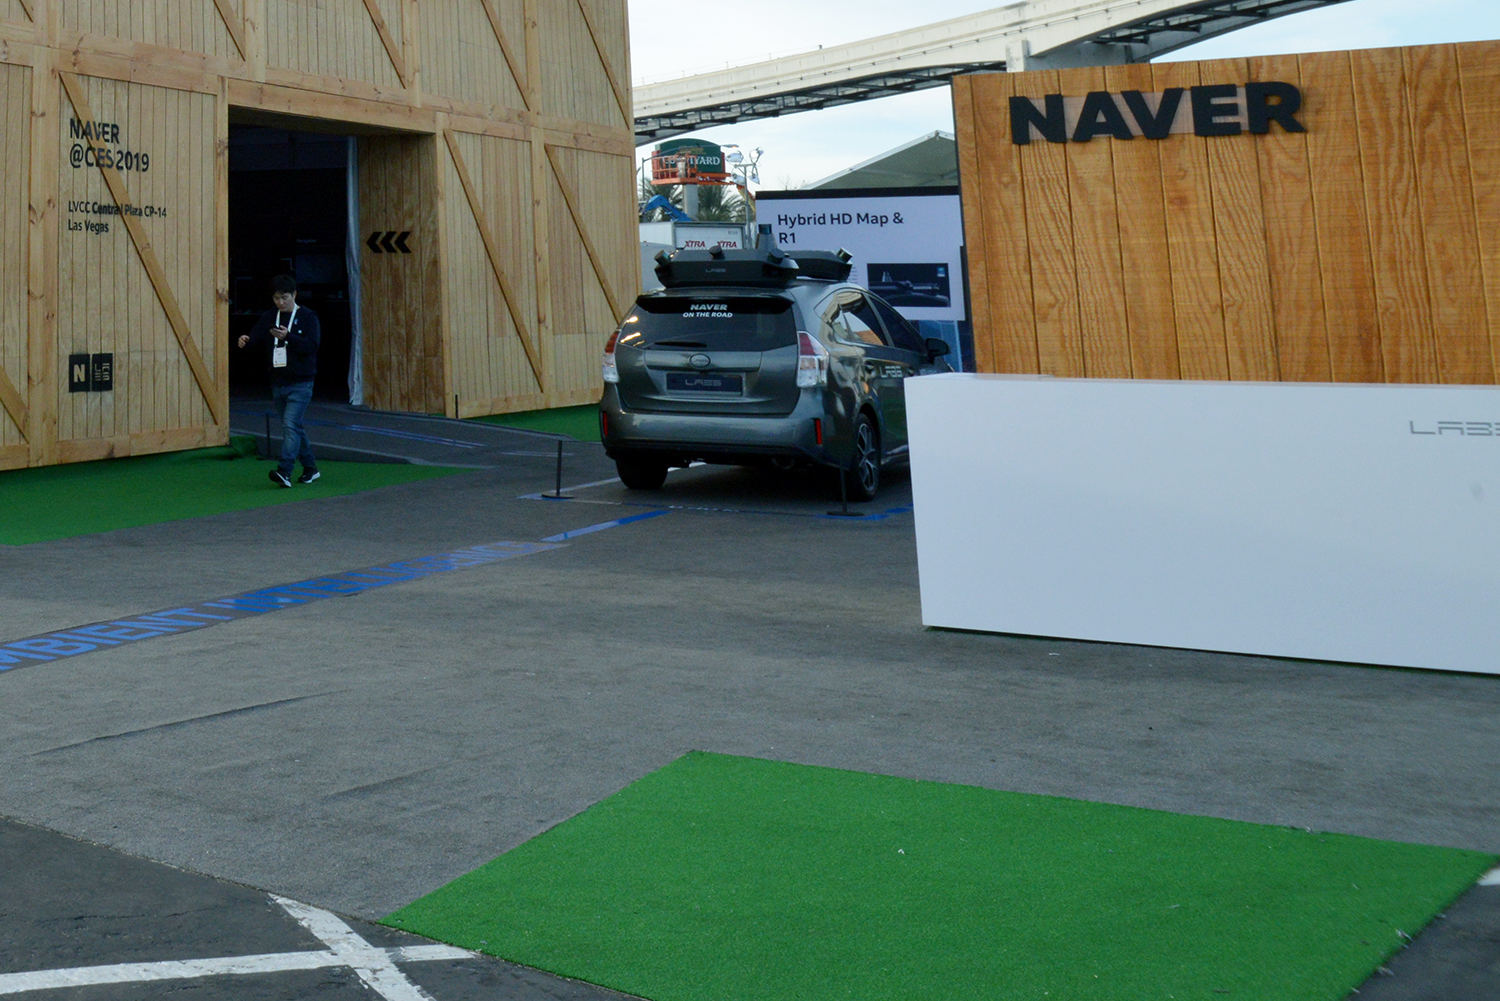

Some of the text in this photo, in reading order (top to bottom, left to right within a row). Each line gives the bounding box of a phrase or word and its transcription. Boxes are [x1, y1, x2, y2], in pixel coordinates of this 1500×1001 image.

[1008, 81, 1307, 145] NAVER
[69, 118, 120, 144] NAVER
[69, 143, 150, 172] @CES 2019
[68, 200, 167, 218] LVCC Central Plaza CP-14
[68, 218, 109, 235] Las Vegas
[778, 212, 904, 229] Hybrid HD Map &
[685, 240, 706, 248] XTRA
[779, 232, 796, 244] R1
[73, 363, 86, 383] N
[1409, 420, 1500, 437] LAB
